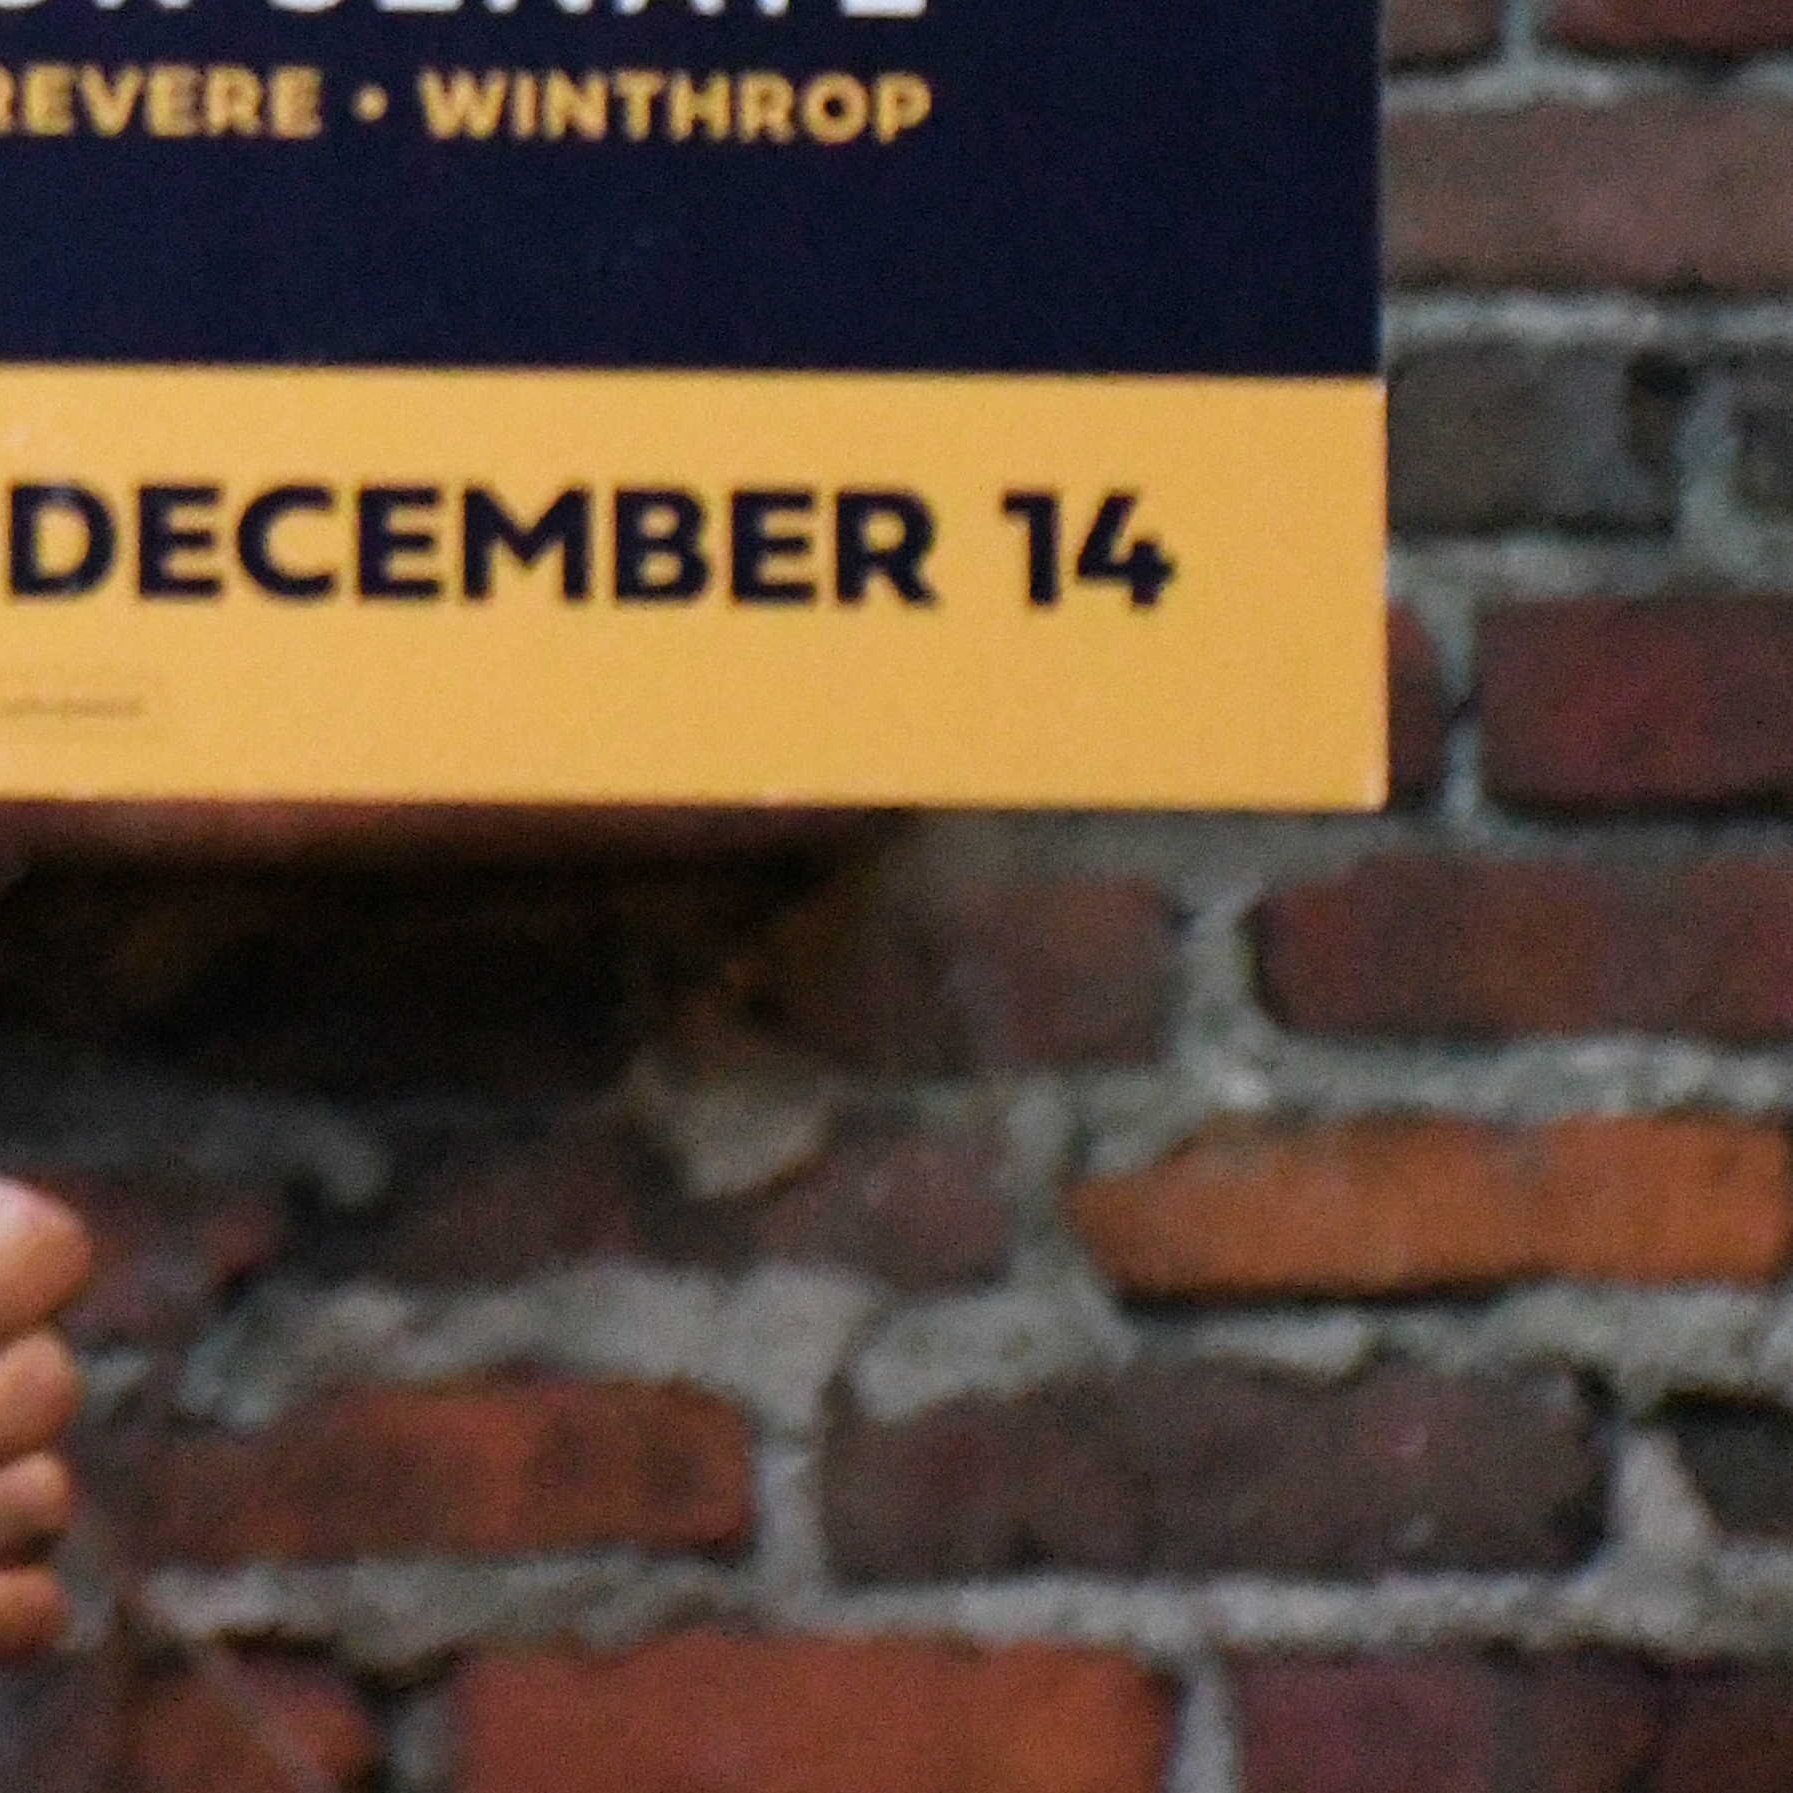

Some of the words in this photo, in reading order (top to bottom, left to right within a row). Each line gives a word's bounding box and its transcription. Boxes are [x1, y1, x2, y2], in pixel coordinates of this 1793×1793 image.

[420, 69, 933, 145] WINTHROP
[5, 480, 938, 610] DECEMBER
[998, 487, 1178, 611] 14
